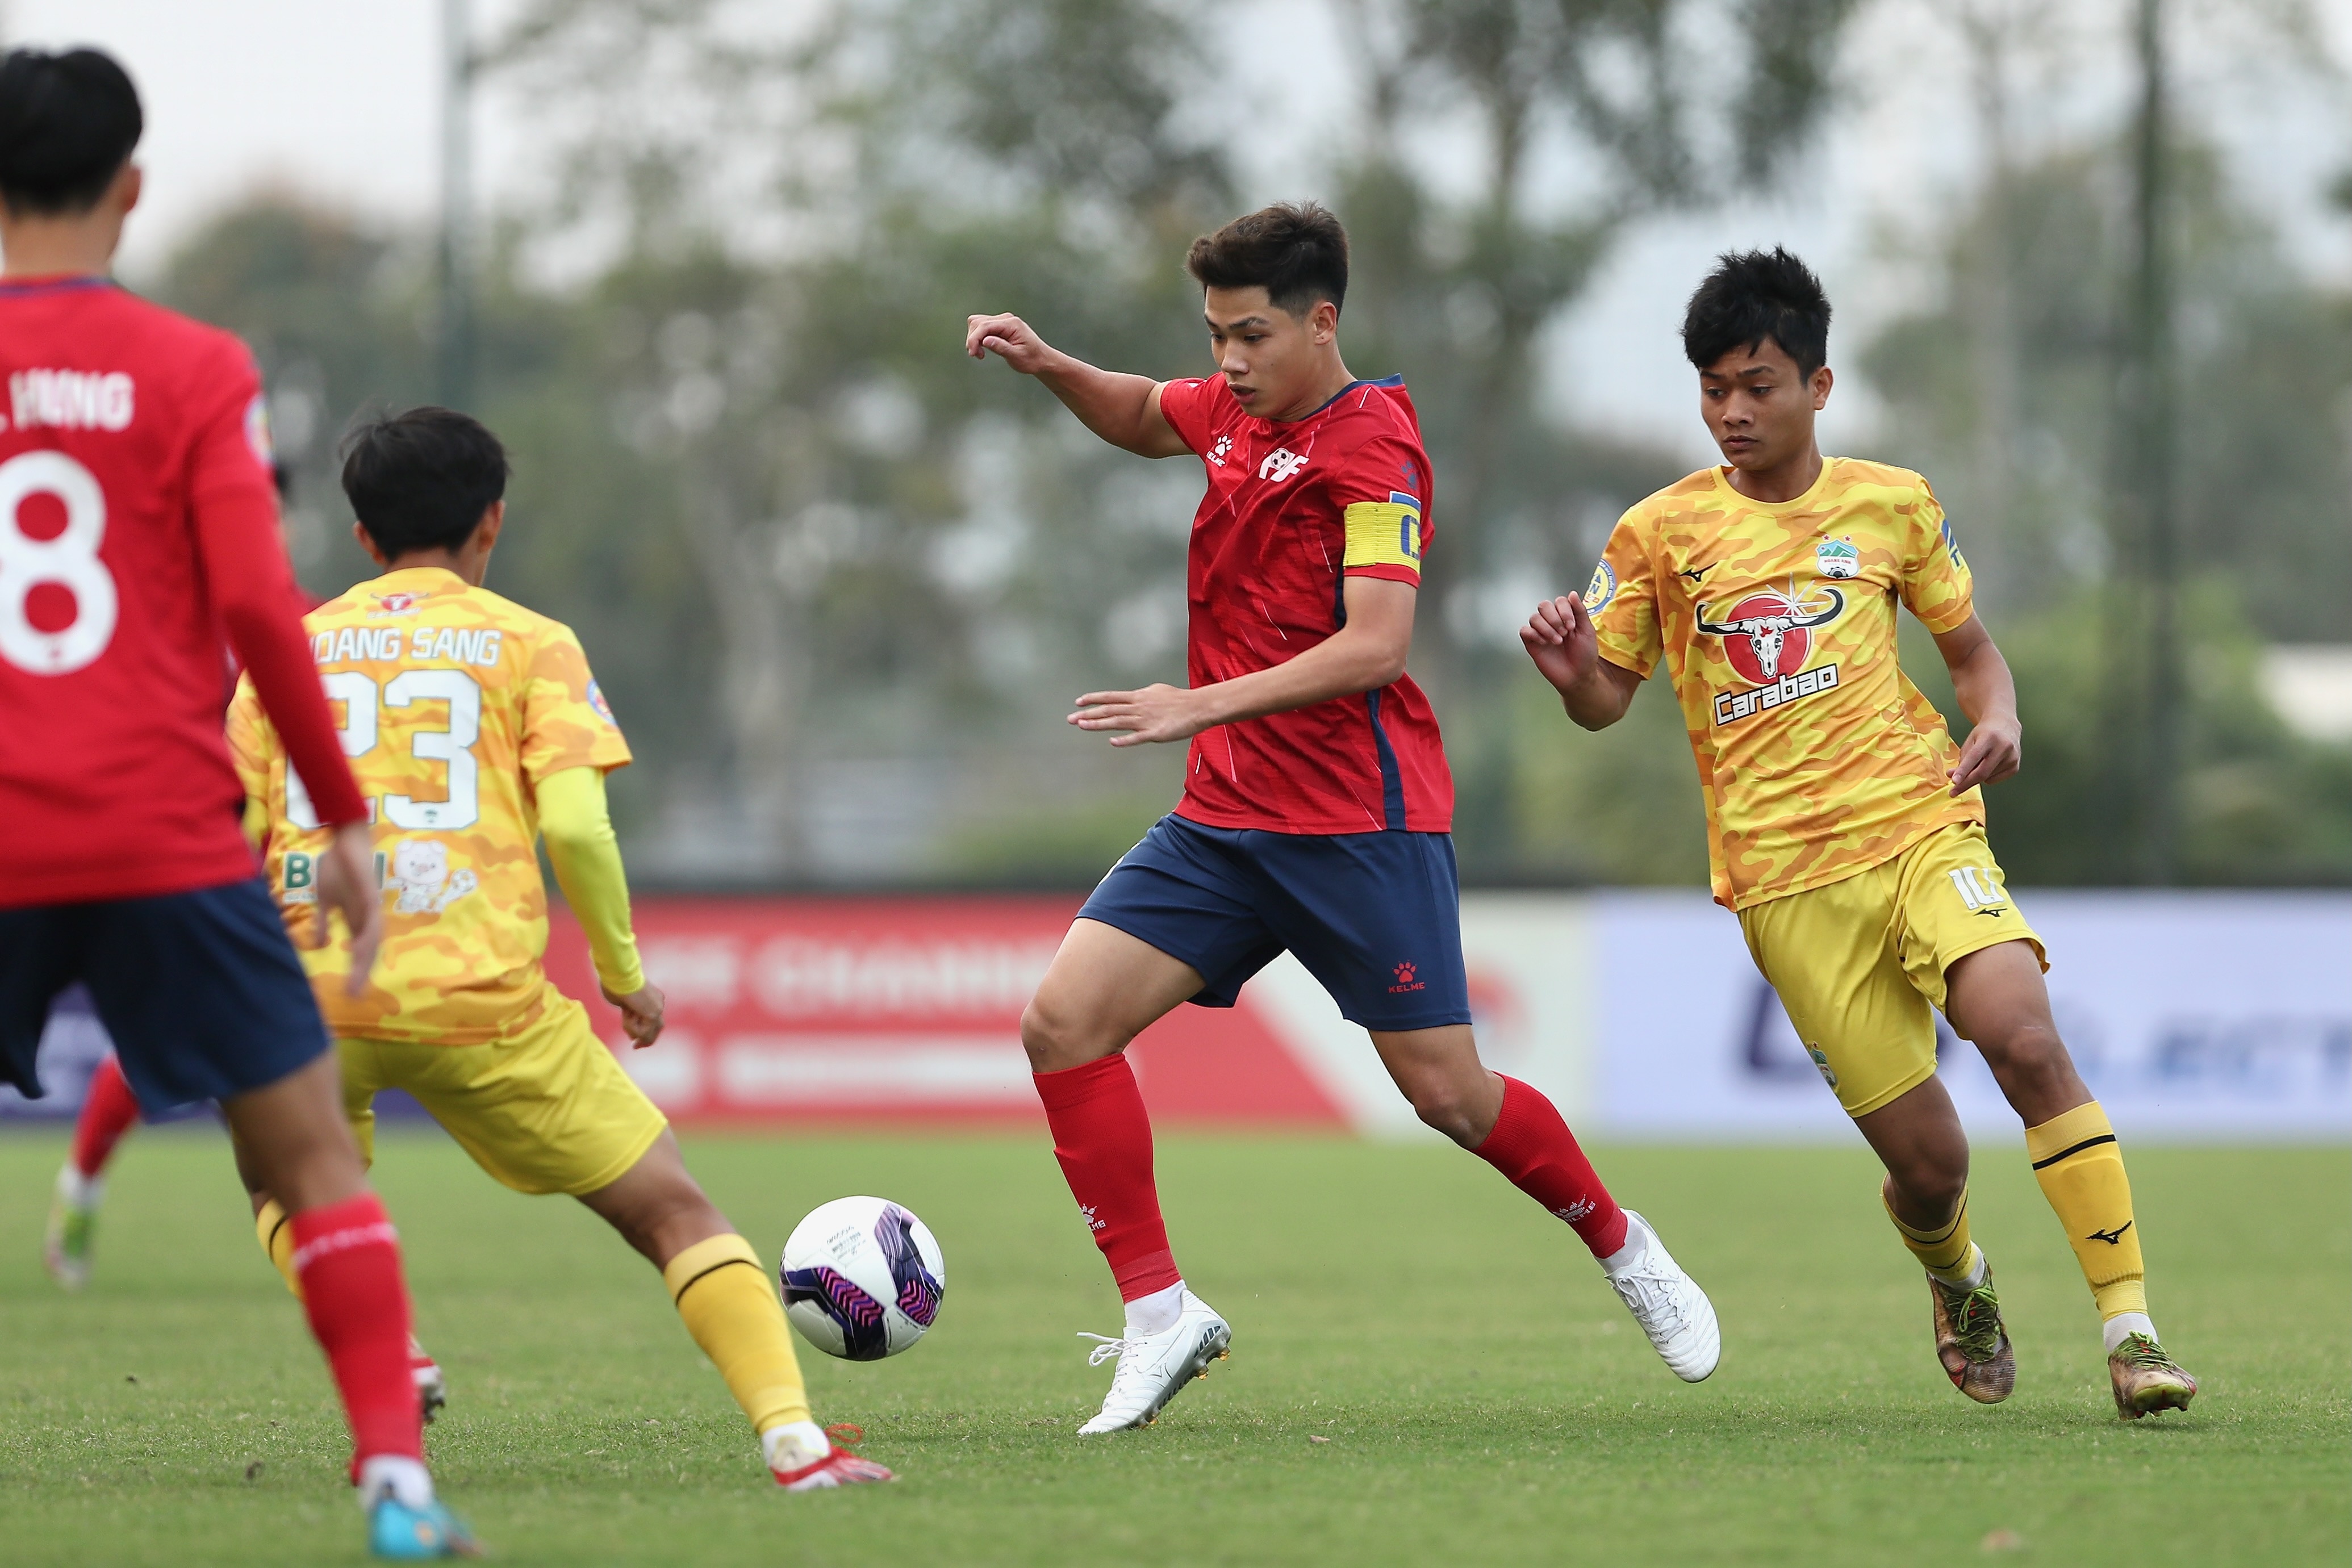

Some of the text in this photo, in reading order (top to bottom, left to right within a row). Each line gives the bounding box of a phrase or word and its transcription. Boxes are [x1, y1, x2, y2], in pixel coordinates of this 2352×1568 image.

[0, 448, 119, 675] 8
[310, 626, 502, 667] OANG SANG
[1714, 663, 1839, 726] Carabao
[1947, 865, 2004, 910] 10
[1388, 982, 1425, 993] KELME
